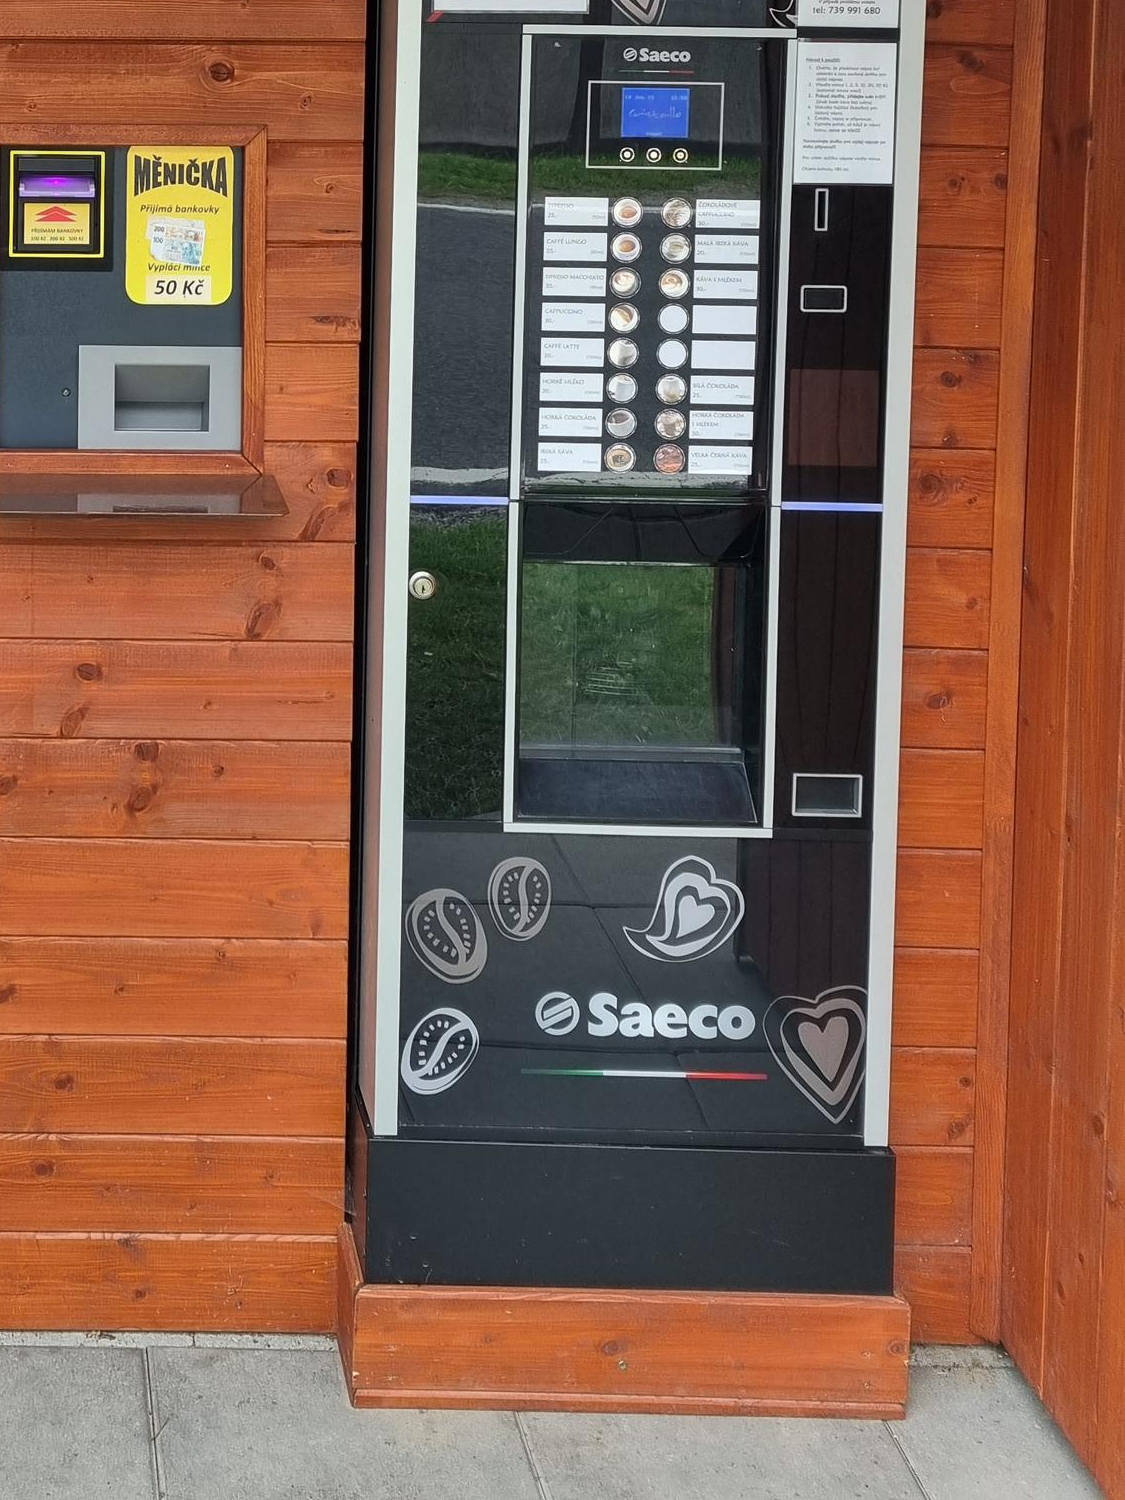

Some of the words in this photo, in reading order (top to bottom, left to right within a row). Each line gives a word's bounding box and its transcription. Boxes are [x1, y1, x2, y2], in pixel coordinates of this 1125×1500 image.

[813, 6, 826, 14] tel:
[828, 6, 844, 14] 739
[864, 7, 881, 15] 680
[639, 47, 691, 62] Saeco
[134, 154, 228, 198] MĚNIČKA
[140, 204, 173, 214] Přijímá
[175, 204, 220, 215] bankovky
[154, 280, 177, 295] 50
[183, 279, 205, 296] Kč
[587, 993, 756, 1040] Saeco
